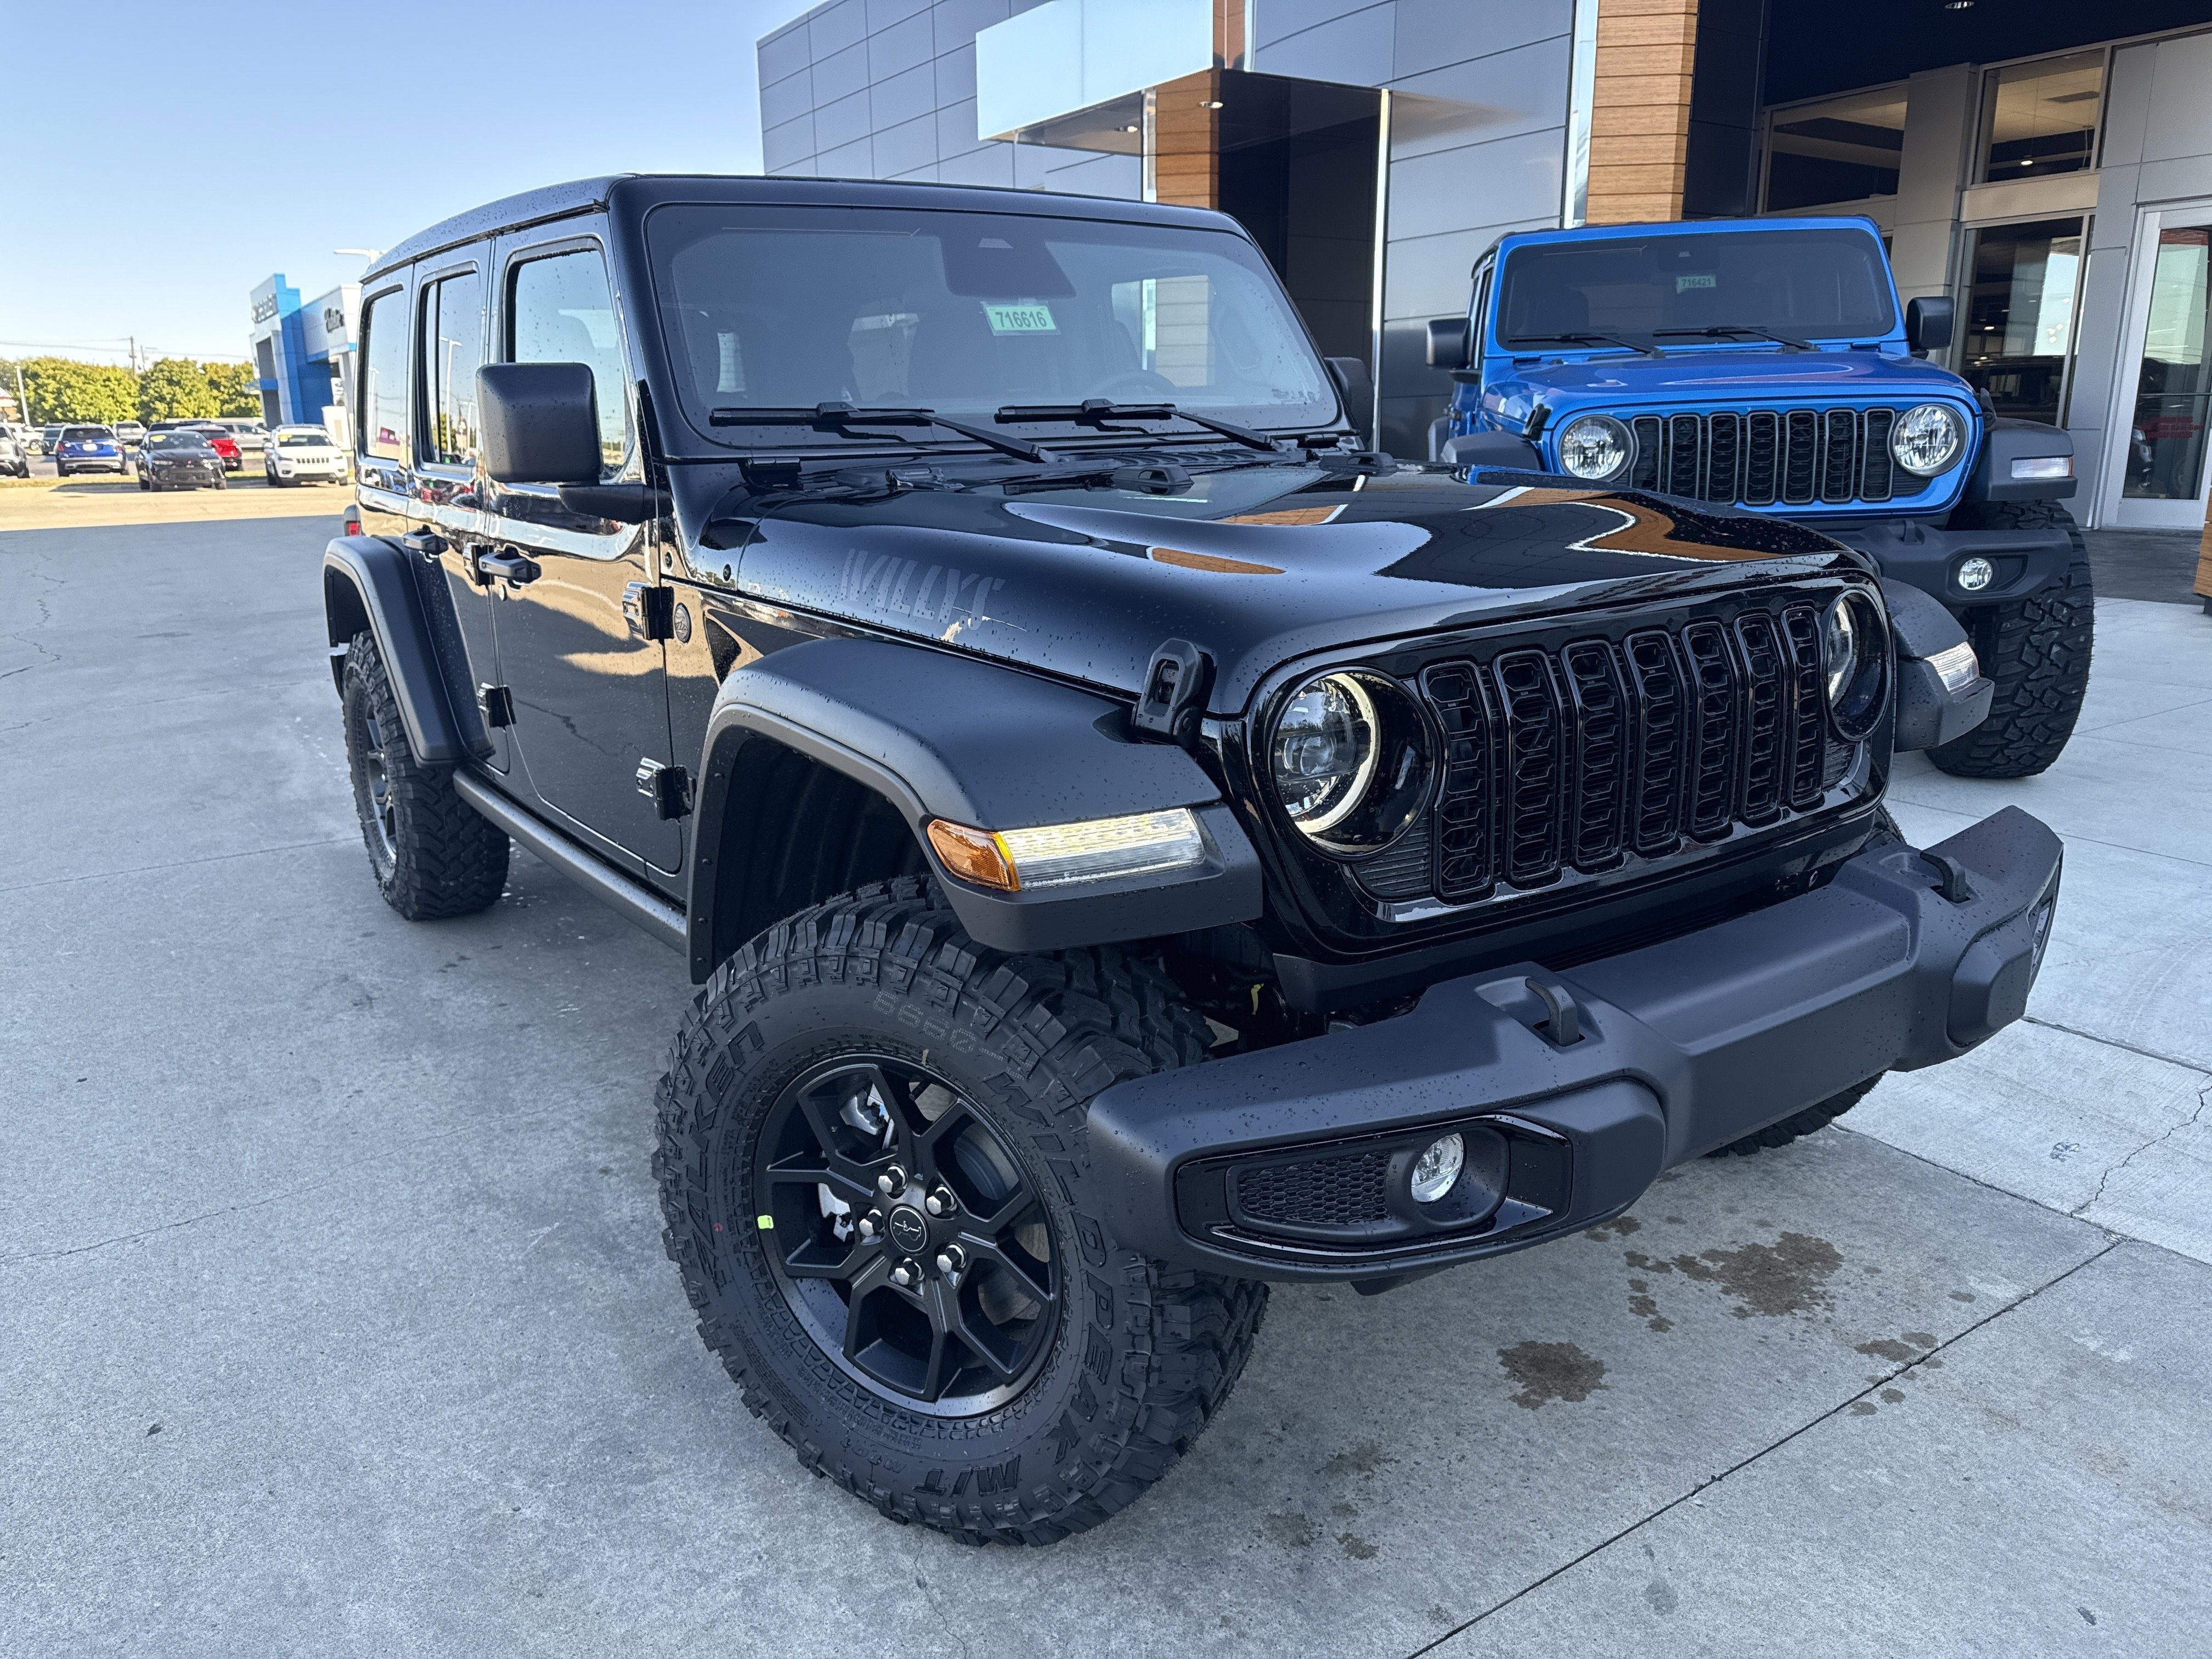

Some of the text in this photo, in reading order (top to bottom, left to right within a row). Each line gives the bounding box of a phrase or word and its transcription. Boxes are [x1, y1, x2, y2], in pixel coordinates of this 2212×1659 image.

[1681, 278, 1711, 287] 716421
[995, 311, 1047, 328] 716616
[840, 548, 1006, 631] WILLYS
[686, 1020, 764, 1296] FALKEN
[912, 1454, 1022, 1498] M/T
